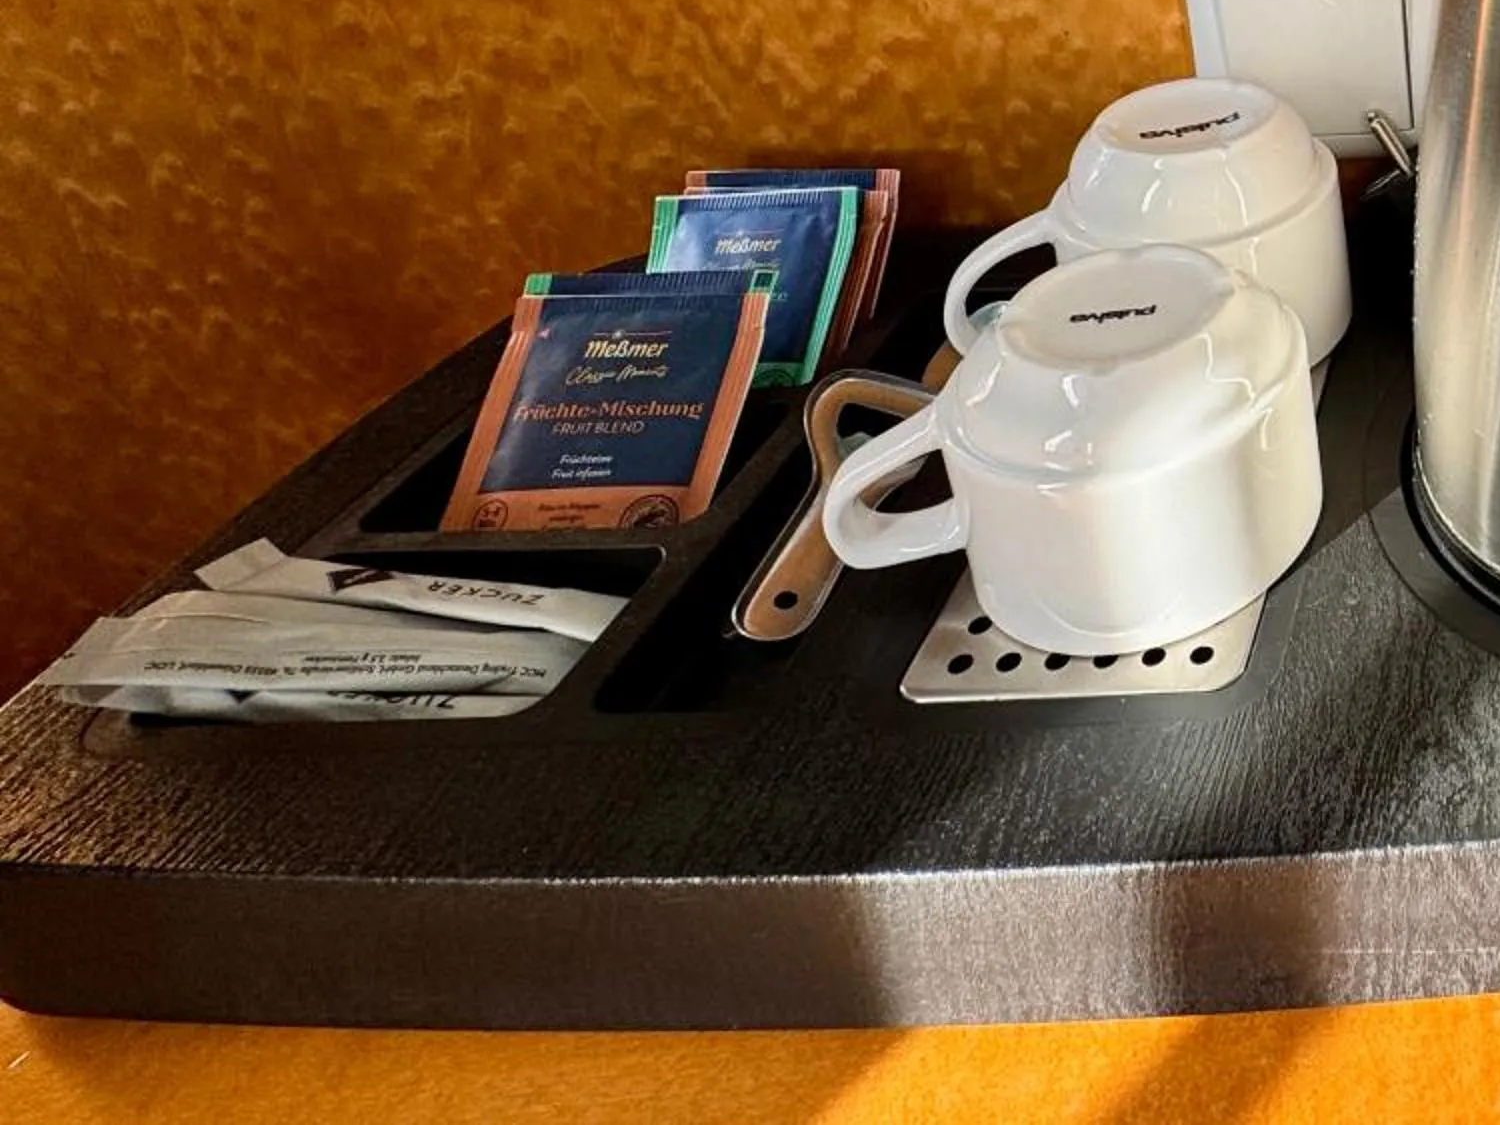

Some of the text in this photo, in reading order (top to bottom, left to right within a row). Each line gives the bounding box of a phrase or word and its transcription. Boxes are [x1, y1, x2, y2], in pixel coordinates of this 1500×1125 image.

[584, 339, 669, 359] Meßmer
[513, 399, 705, 420] Früchte-Mischung
[552, 420, 646, 437] FRUIT BLEND
[427, 579, 545, 606] ZUCKER
